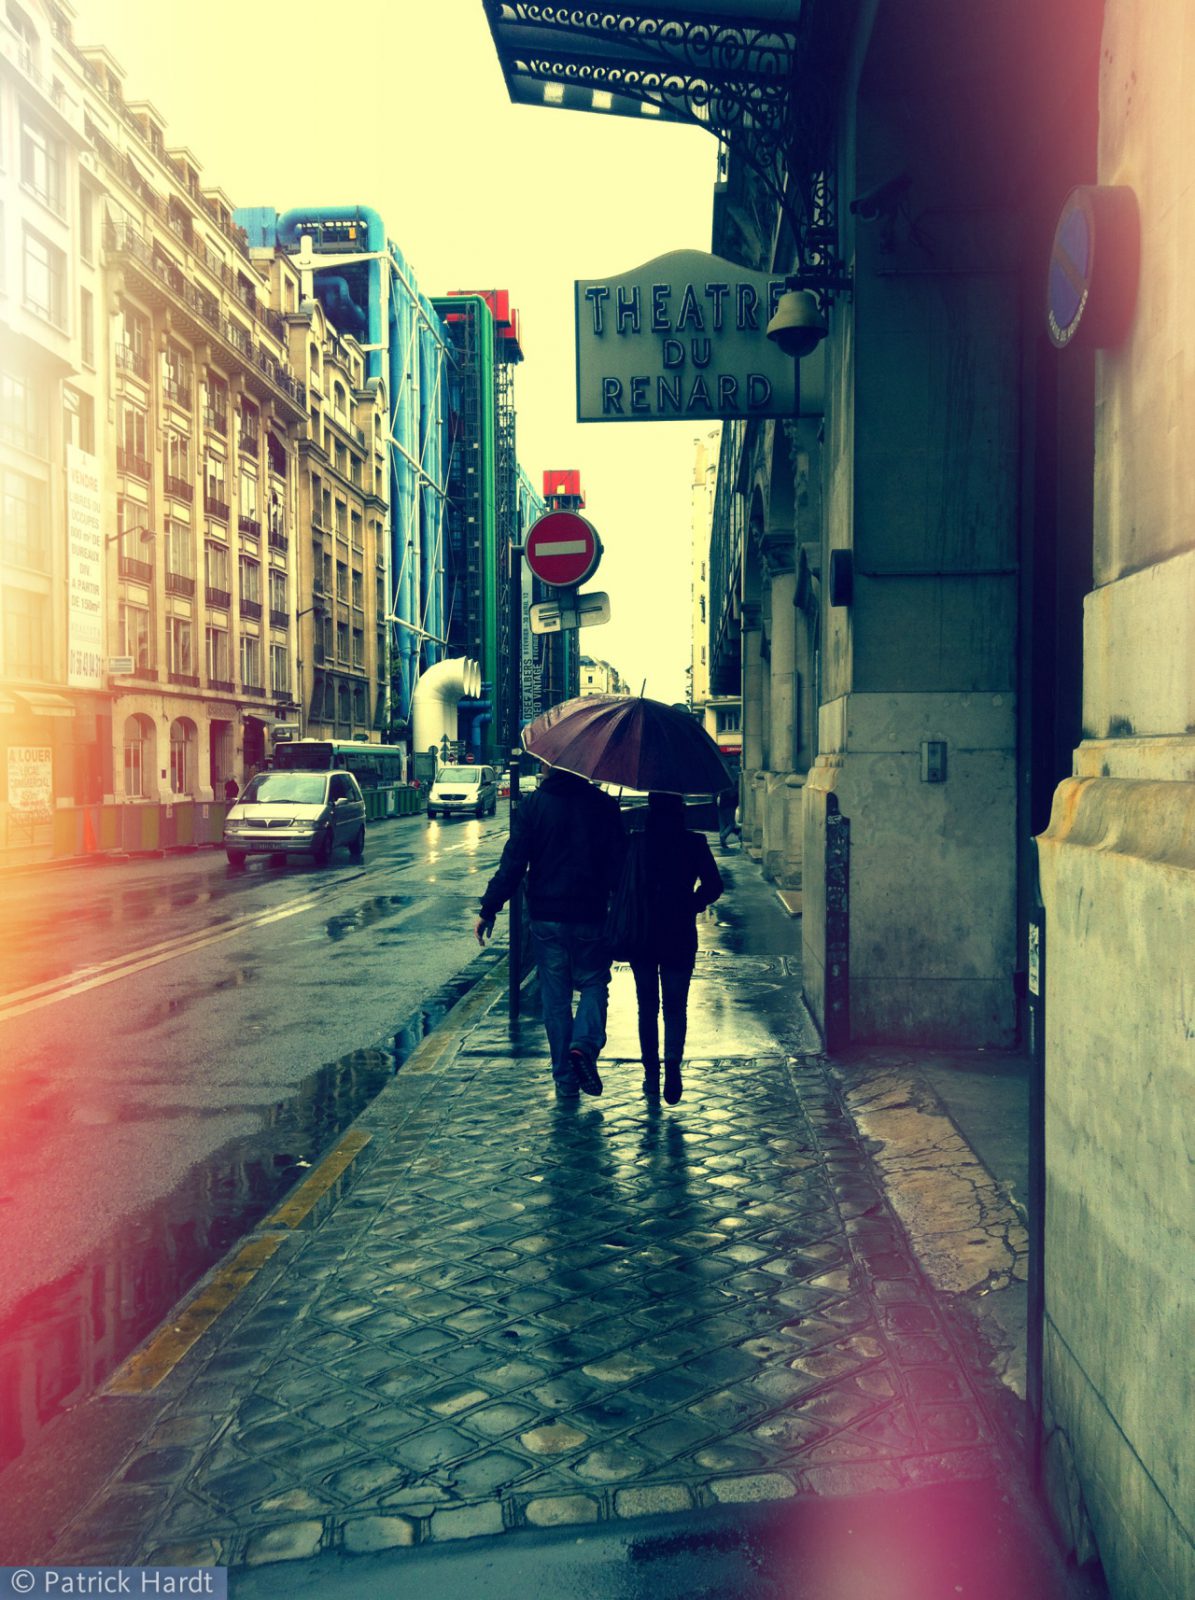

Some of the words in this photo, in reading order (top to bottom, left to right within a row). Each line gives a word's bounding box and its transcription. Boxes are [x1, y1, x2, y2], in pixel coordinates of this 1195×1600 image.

[663, 338, 711, 369] DU
[602, 374, 772, 414] RENARD
[71, 468, 99, 493] VENDRE
[92, 534, 101, 547] DE
[71, 543, 100, 562] BUREAUX
[77, 579, 100, 596] PARTIR
[71, 595, 80, 608] DE
[523, 659, 533, 697] ALBERS
[533, 663, 542, 699] VINTAGE
[18, 748, 51, 762] LOUER
